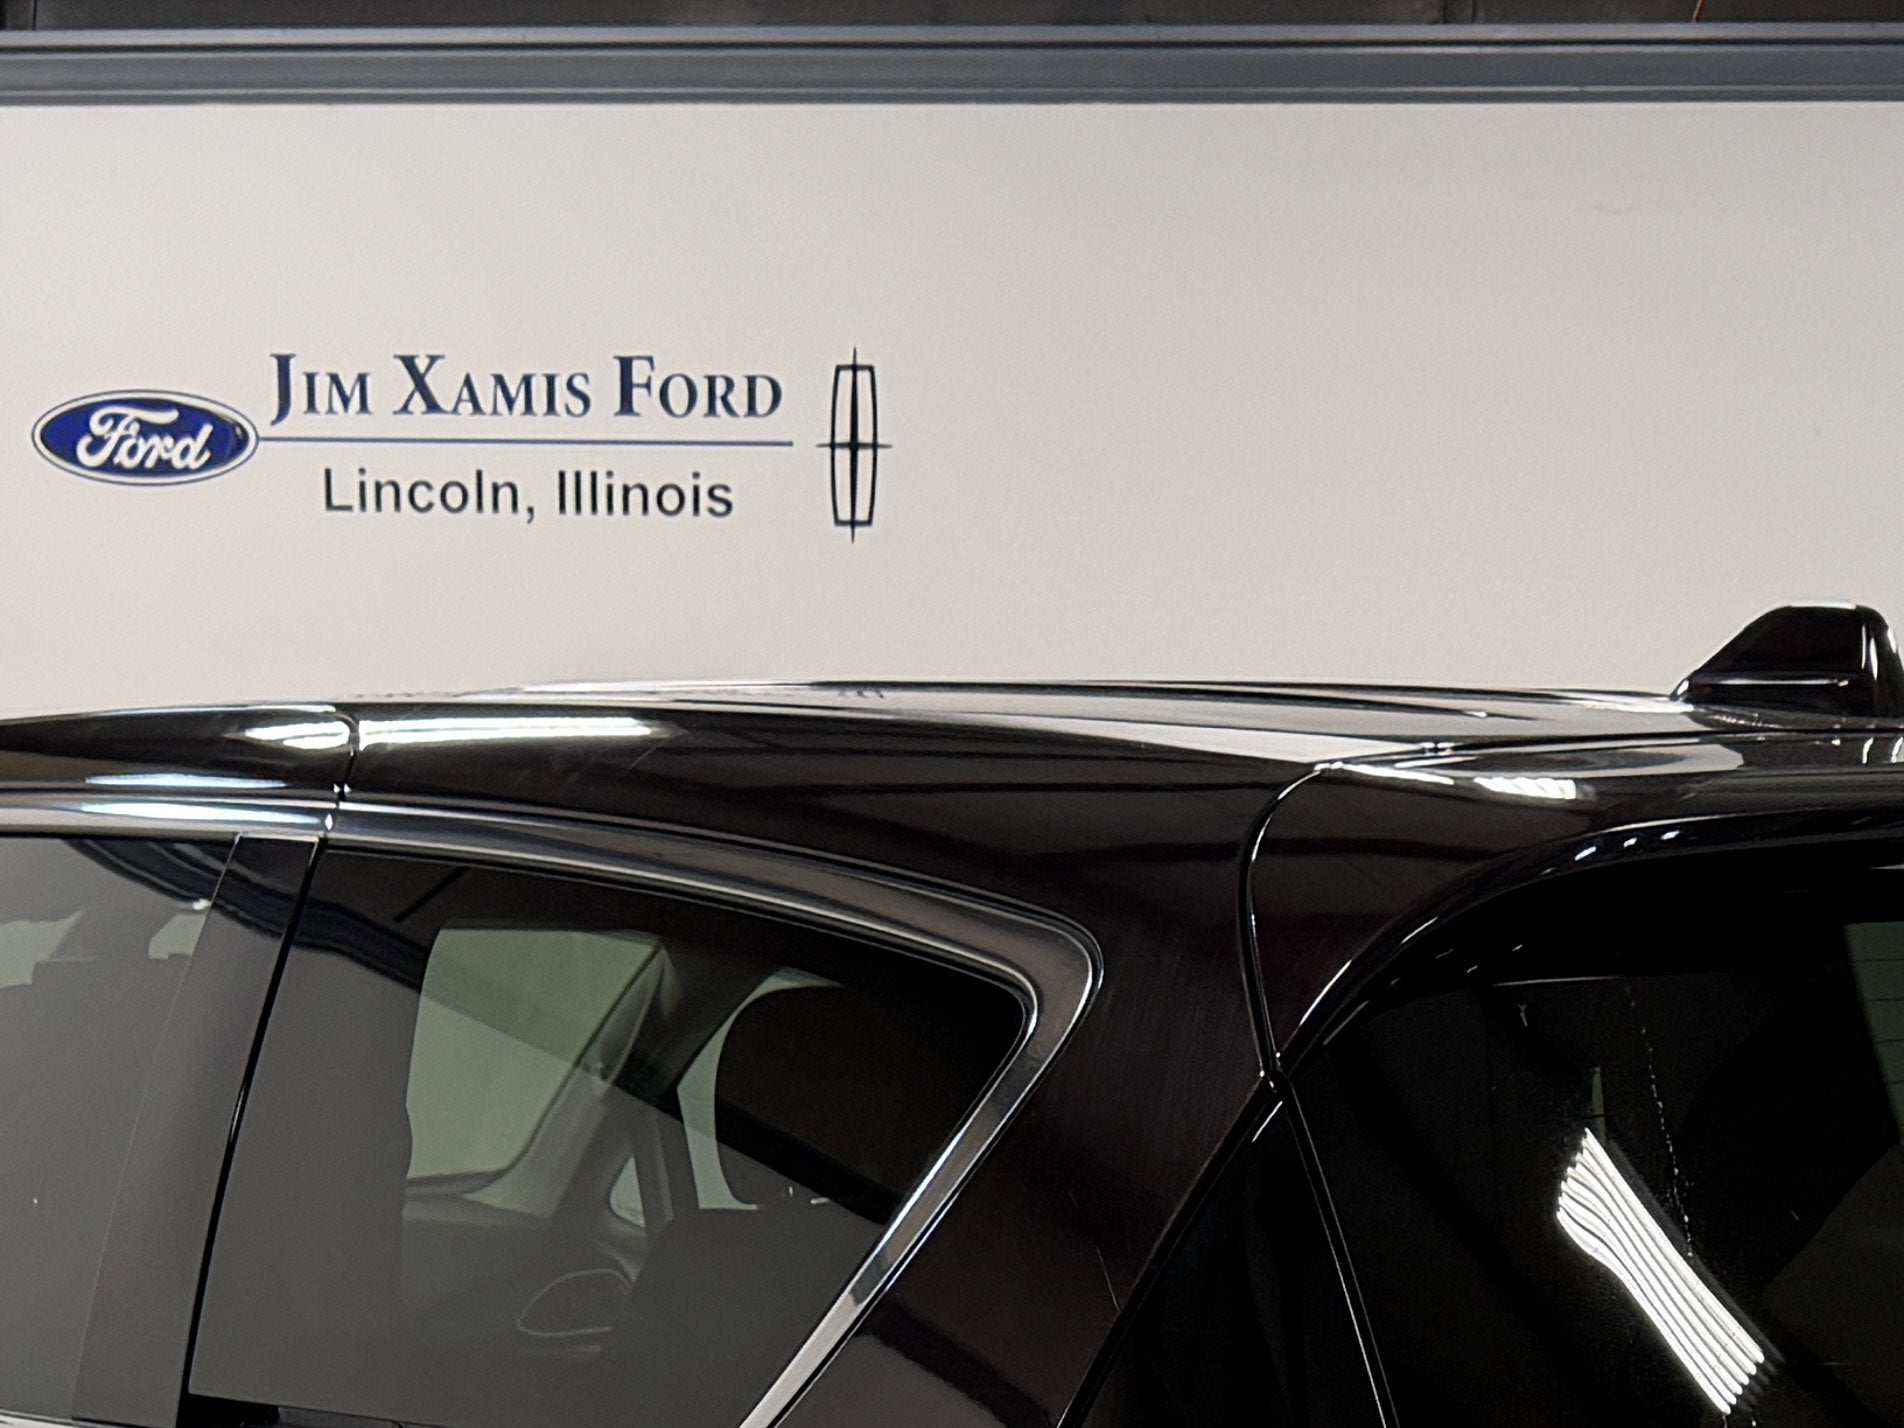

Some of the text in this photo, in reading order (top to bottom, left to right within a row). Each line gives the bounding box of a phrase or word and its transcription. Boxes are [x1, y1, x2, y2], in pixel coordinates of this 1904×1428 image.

[270, 353, 782, 426] JIM XAMIS FORD
[76, 406, 211, 470] Ford
[324, 469, 734, 523] Lincoln, Illinois
